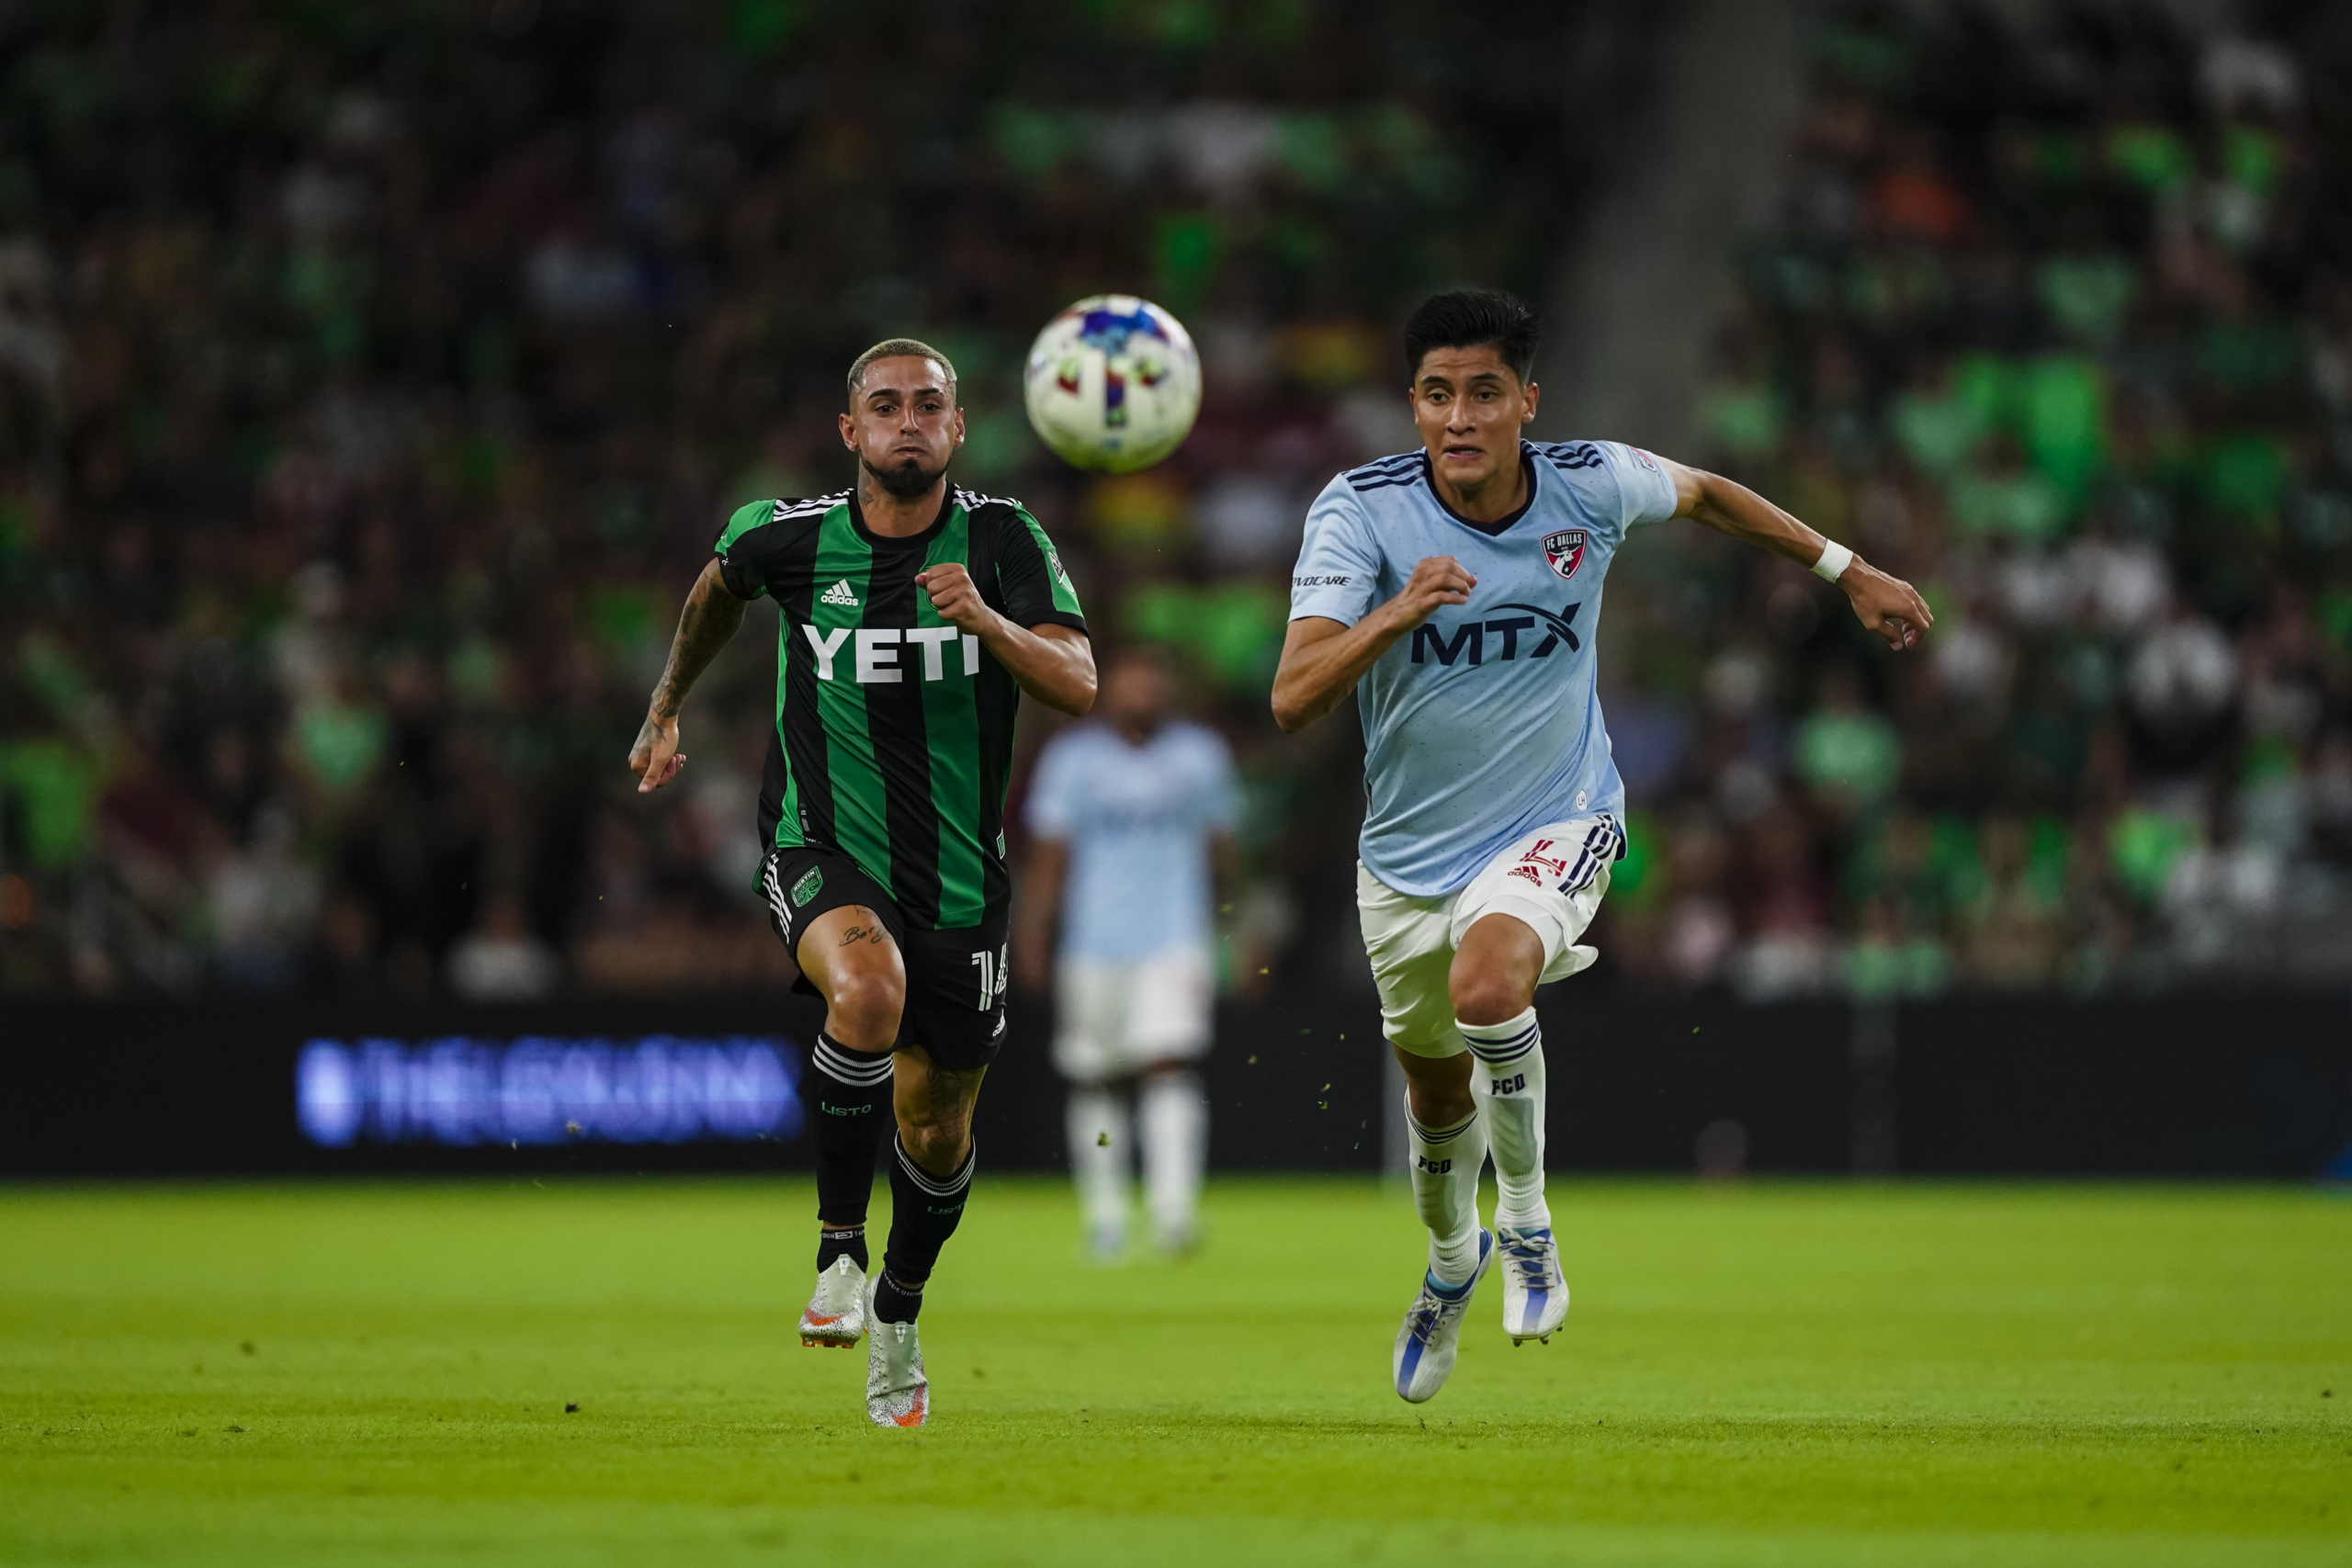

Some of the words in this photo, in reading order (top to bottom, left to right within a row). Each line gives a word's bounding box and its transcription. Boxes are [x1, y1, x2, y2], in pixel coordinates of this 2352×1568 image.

[1546, 537, 1555, 550] FC
[1557, 534, 1582, 547] DALLAS
[820, 594, 859, 606] adidas
[1411, 602, 1581, 666] MTX
[801, 624, 979, 682] YETI
[794, 870, 815, 891] AUSTIN
[1507, 870, 1543, 887] adidas
[1491, 1073, 1525, 1096] FCD
[821, 1101, 872, 1116] LISTO
[1418, 1155, 1452, 1174] FCD
[927, 1201, 967, 1215] LIST
